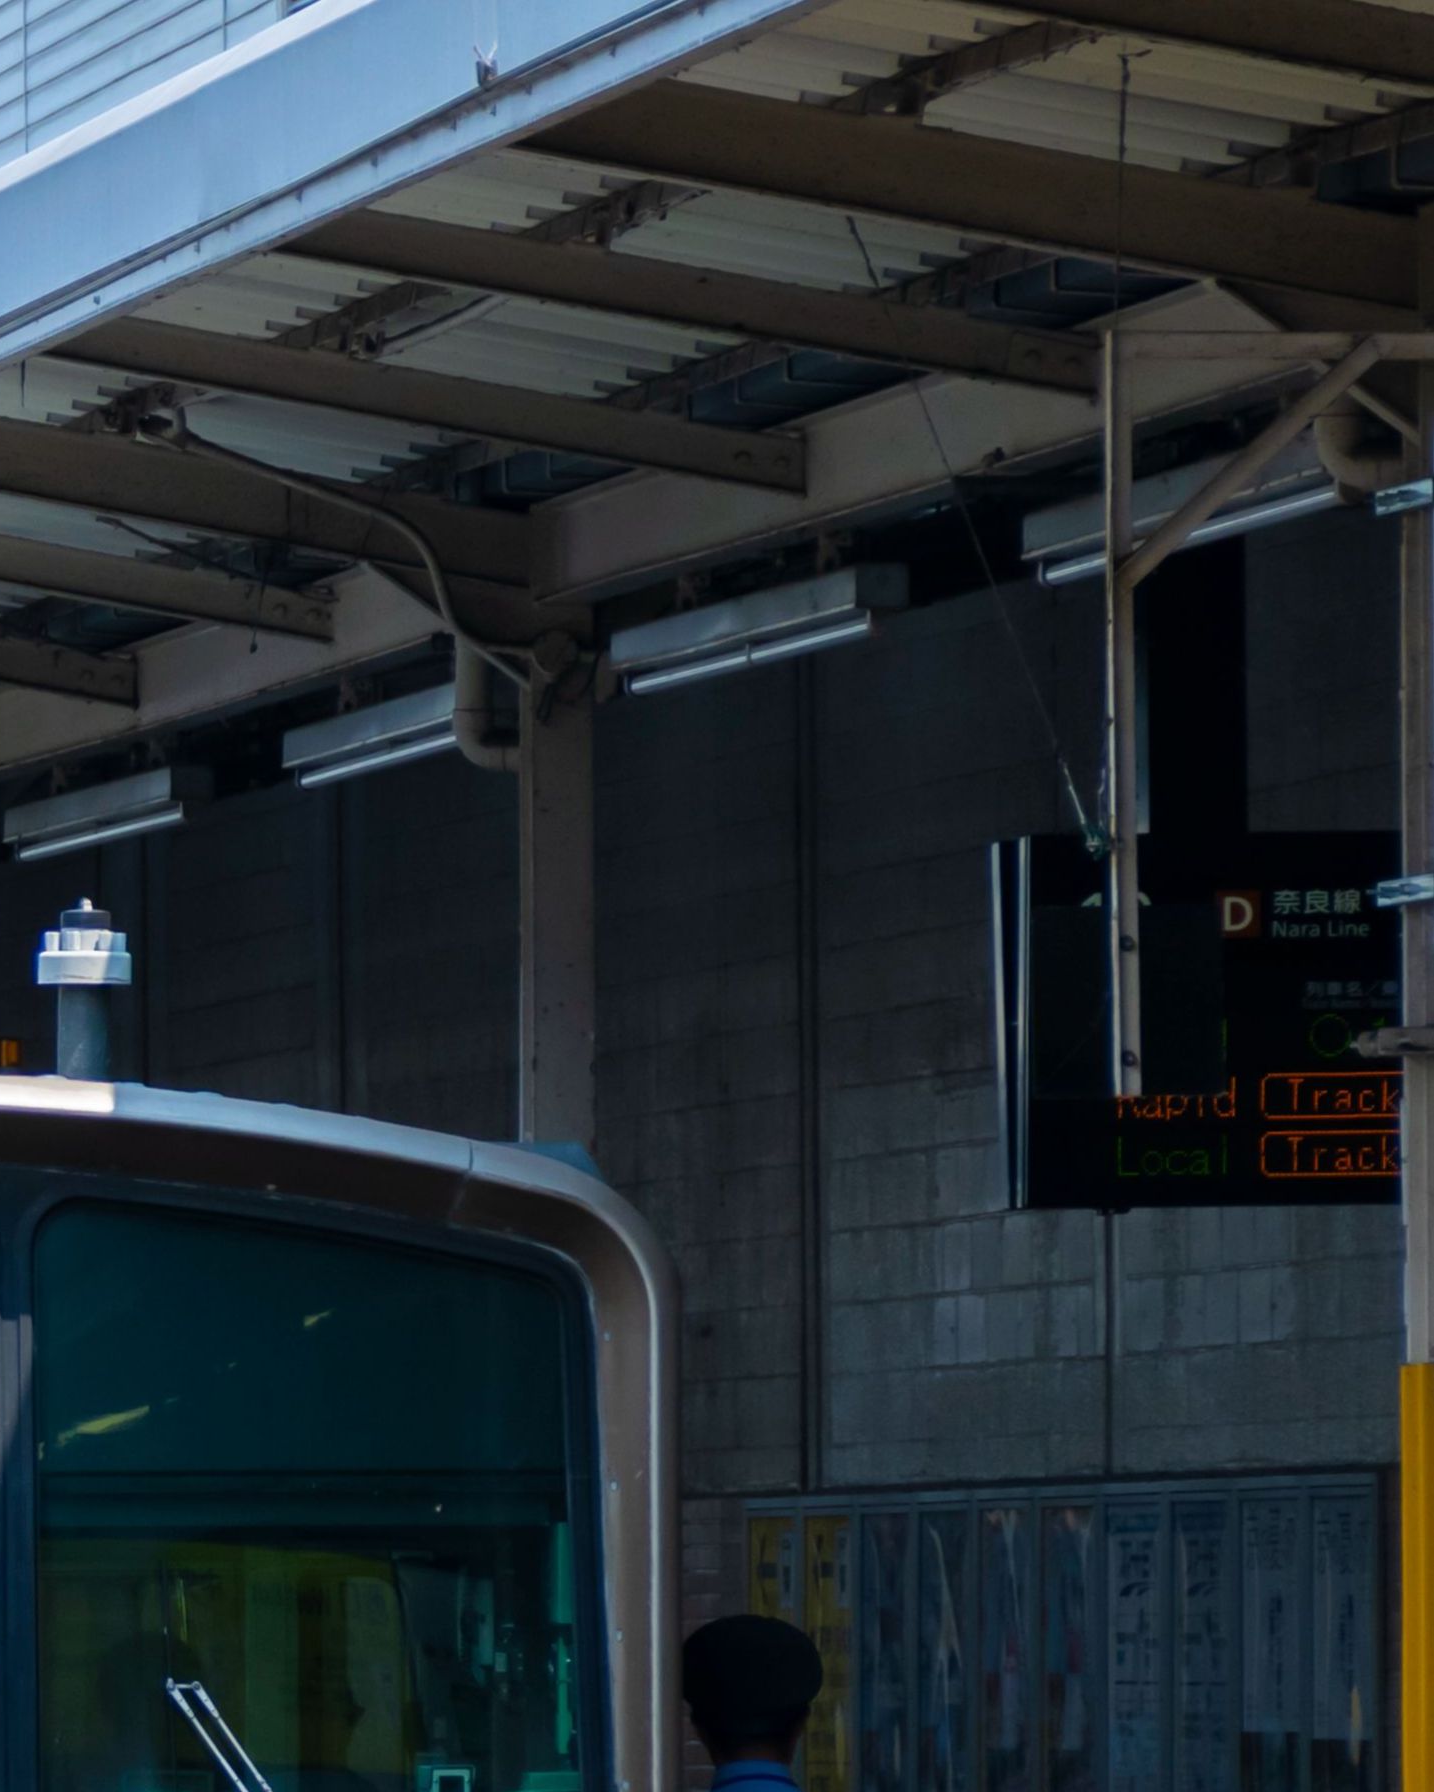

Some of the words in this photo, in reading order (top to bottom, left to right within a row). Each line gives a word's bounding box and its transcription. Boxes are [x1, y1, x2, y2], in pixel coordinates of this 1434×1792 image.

[1223, 896, 1253, 932] D
[1273, 889, 1361, 915] 奈良線
[1272, 921, 1321, 937] Nara
[1328, 920, 1370, 938] Line
[1288, 1078, 1400, 1114] Track
[1117, 1135, 1228, 1176] Local
[1287, 1136, 1400, 1172] Track
